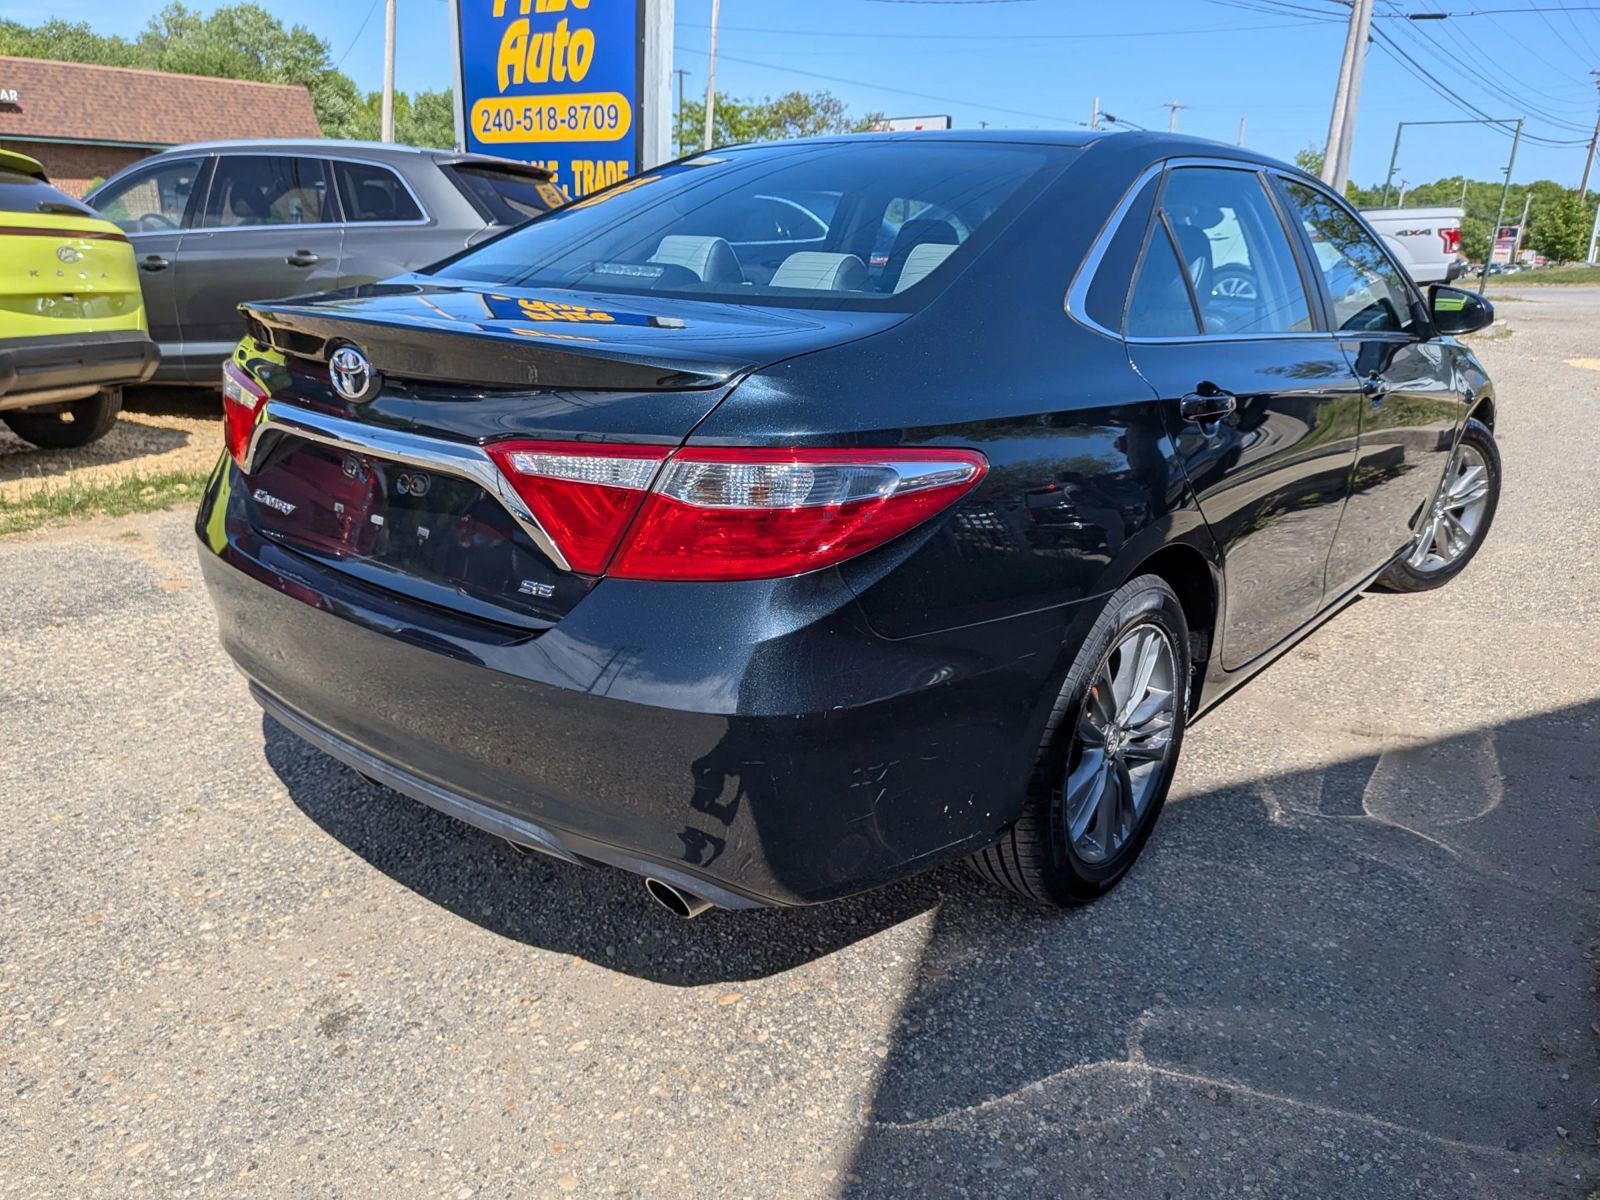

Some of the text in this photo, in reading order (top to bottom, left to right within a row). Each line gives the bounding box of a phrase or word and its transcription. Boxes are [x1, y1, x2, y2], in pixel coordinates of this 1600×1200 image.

[497, 18, 595, 94] Auto
[481, 104, 619, 132] 240-518-8709
[518, 580, 555, 598] SE
